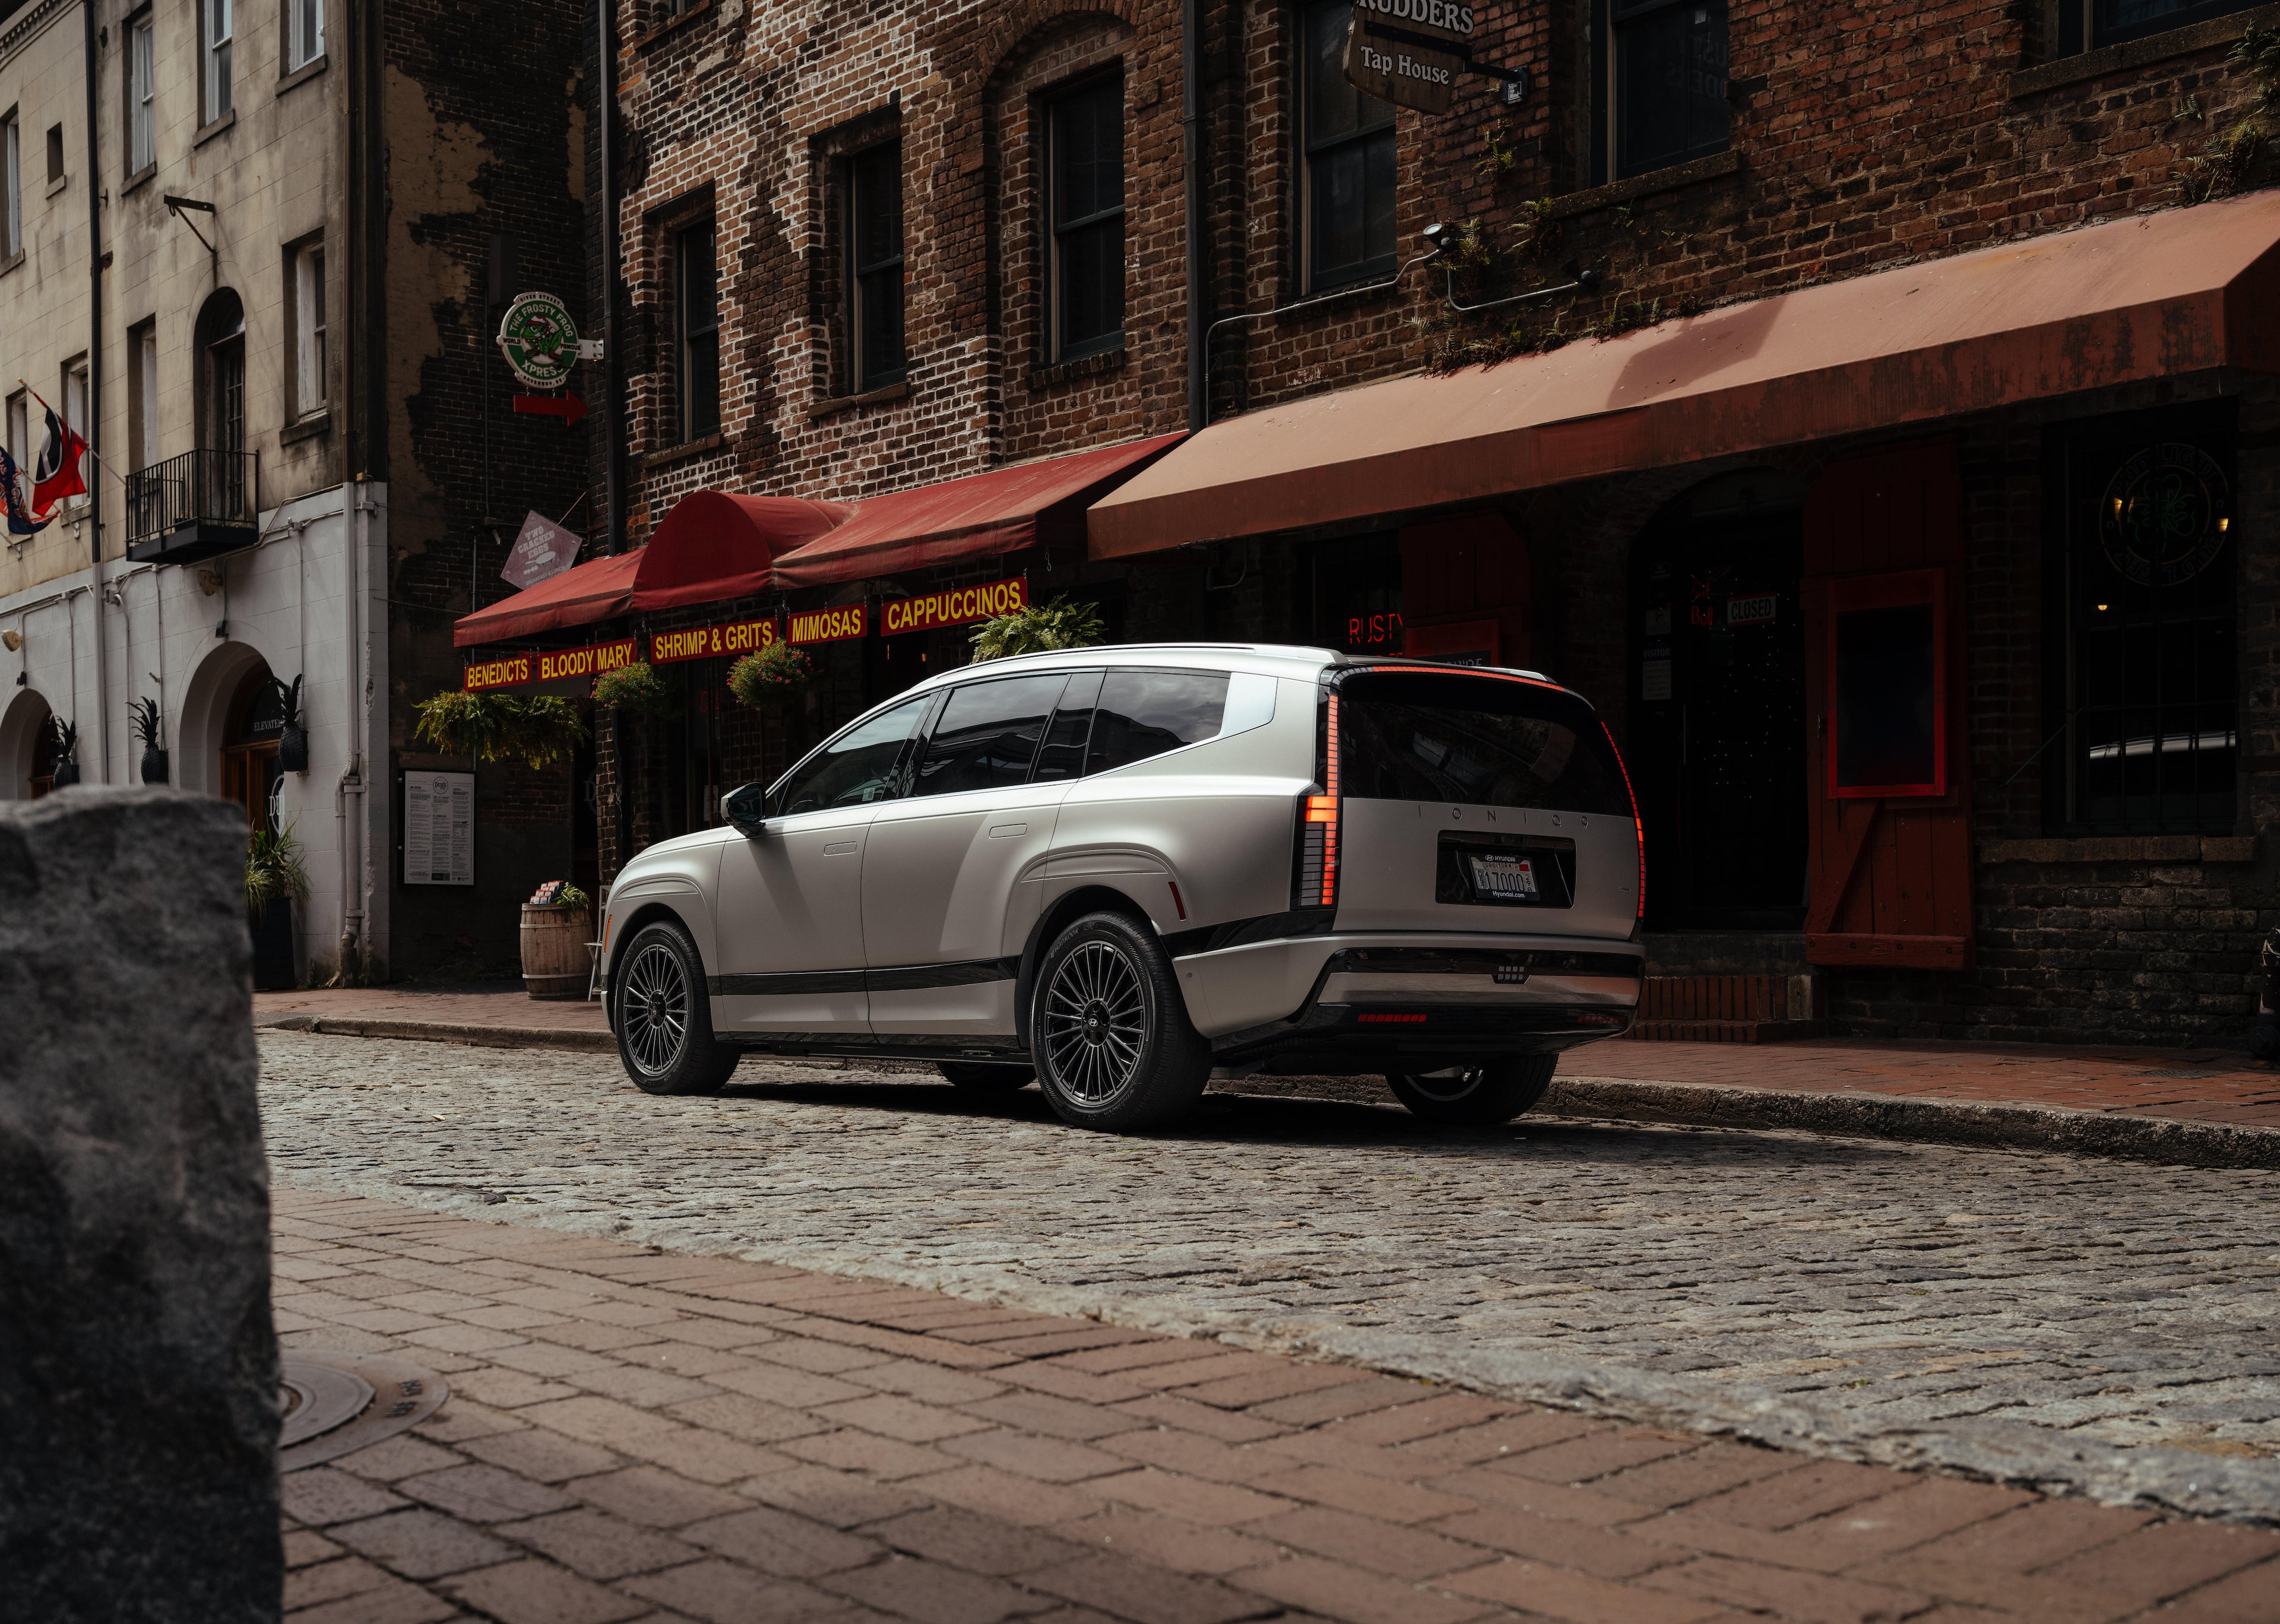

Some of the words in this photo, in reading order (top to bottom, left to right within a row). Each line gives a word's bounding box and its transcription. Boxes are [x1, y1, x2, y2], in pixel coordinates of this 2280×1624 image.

[1360, 45, 1392, 76] Tap
[1397, 54, 1449, 85] House
[539, 294, 560, 305] STREET
[509, 313, 523, 331] THE
[521, 304, 556, 316] FROSTY
[556, 313, 574, 337] FROG
[518, 530, 555, 554] CRACKED
[525, 525, 544, 540] TWO
[527, 543, 549, 559] EGGS
[526, 573, 547, 585] BREAKFAST
[888, 582, 1021, 630] CAPPUCCINOS
[1691, 605, 1713, 627] Bull
[1731, 598, 1771, 620] CLOSED
[792, 609, 861, 642] MIMOSAS
[656, 630, 707, 659] SHRIMP
[711, 628, 722, 652] &
[726, 621, 772, 650] GRITS
[542, 650, 594, 679] BLOODY
[597, 643, 632, 671] MARY
[468, 659, 528, 688] BENEDICTS
[1485, 871, 1525, 892] 17000
